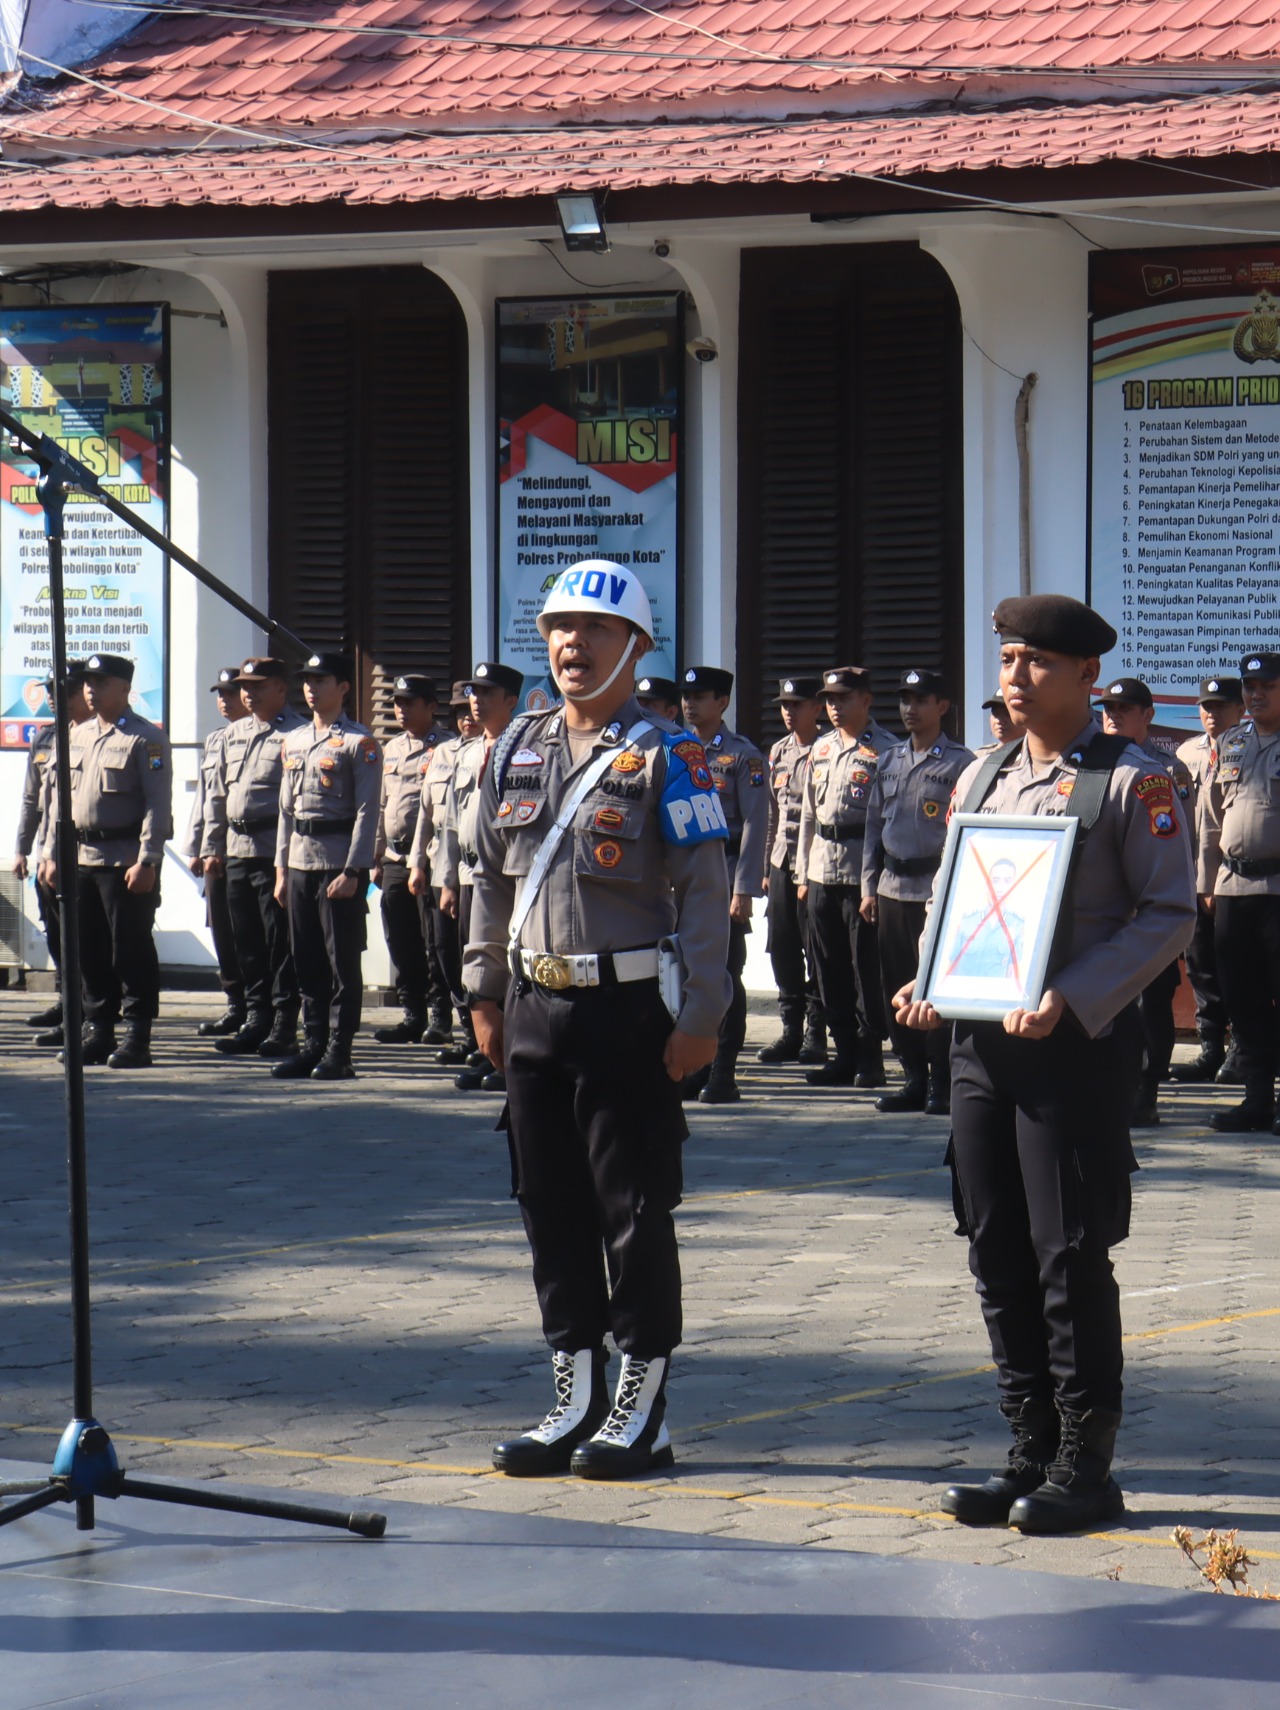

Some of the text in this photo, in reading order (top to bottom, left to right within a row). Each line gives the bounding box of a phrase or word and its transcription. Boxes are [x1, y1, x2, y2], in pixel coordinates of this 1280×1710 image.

[1123, 380, 1145, 410] 16
[1147, 377, 1234, 410] PROGRAM
[1124, 419, 1247, 431] 1. Penataan Kelembagaan
[576, 418, 671, 464] MISI
[1124, 437, 1131, 447] 2.
[1140, 436, 1188, 447] Perubahan
[1191, 435, 1222, 445] Sistem
[1225, 434, 1242, 444] dan
[1246, 433, 1279, 443] Metode
[1124, 453, 1131, 463] 3.
[1140, 452, 1190, 465] Menjadikan
[1194, 451, 1214, 461] SDM
[1218, 450, 1239, 460] Polri
[1242, 452, 1264, 462] yang
[1123, 469, 1131, 479] 4.
[1139, 468, 1187, 478] Perubahan
[1191, 466, 1235, 479] Teknologi
[123, 484, 151, 503] KOTA
[1123, 485, 1130, 495] 5.
[1139, 484, 1195, 496] Pemantapan
[1198, 482, 1230, 495] Kinerja
[518, 495, 610, 510] Mengayomi dan
[1123, 500, 1130, 510] 6.
[1139, 500, 1195, 512] Peningkatan
[1198, 498, 1230, 511] Kinerja
[518, 513, 644, 528] Melayani Masyarakat
[1123, 516, 1130, 526] 7.
[1139, 516, 1194, 527] Pemantapan
[1198, 515, 1244, 526] Dukungan
[1248, 513, 1269, 523] Polri
[72, 528, 89, 540] dan
[1123, 529, 1272, 542] 8. Pemulihan Ekonomi Nasional
[518, 534, 597, 548] di lingkungan
[19, 546, 142, 558] di wilayah hukum
[518, 552, 554, 565] Polres
[1122, 548, 1130, 558] 9.
[1138, 547, 1181, 560] Menjamin
[1185, 547, 1232, 557] Keamanan
[1236, 546, 1275, 558] Program
[22, 563, 50, 574] Polres
[1123, 564, 1134, 573] 10.
[1138, 564, 1186, 575] Penguatan
[1189, 563, 1246, 575] Penanganan
[1123, 579, 1134, 589] 11.
[1137, 579, 1193, 591] Peningkatan
[1196, 578, 1233, 588] Kualitas
[1123, 595, 1134, 605] 12.
[1138, 595, 1194, 607] Mewujudkan
[1197, 594, 1244, 606] Pelayanan
[1248, 594, 1276, 603] Publik
[82, 605, 142, 618] Kota menjadi
[1122, 611, 1134, 621] 13.
[1138, 611, 1193, 623] Pemantapan
[1197, 610, 1251, 620] Komunikasi
[13, 623, 149, 635] wilayah aman dan tertib
[1122, 627, 1134, 636] 14.
[1137, 627, 1194, 639] Pengawasan
[1197, 626, 1240, 638] Pimpinan
[31, 640, 131, 653] atas dan fungsi
[1122, 642, 1280, 655] 15. Penguatan Fungsi Pengawasan
[24, 657, 52, 668] Polres
[1122, 658, 1134, 668] 16.
[1136, 658, 1194, 670] Pengawasan
[1196, 658, 1216, 668] oleh
[1136, 674, 1167, 684] (Public
